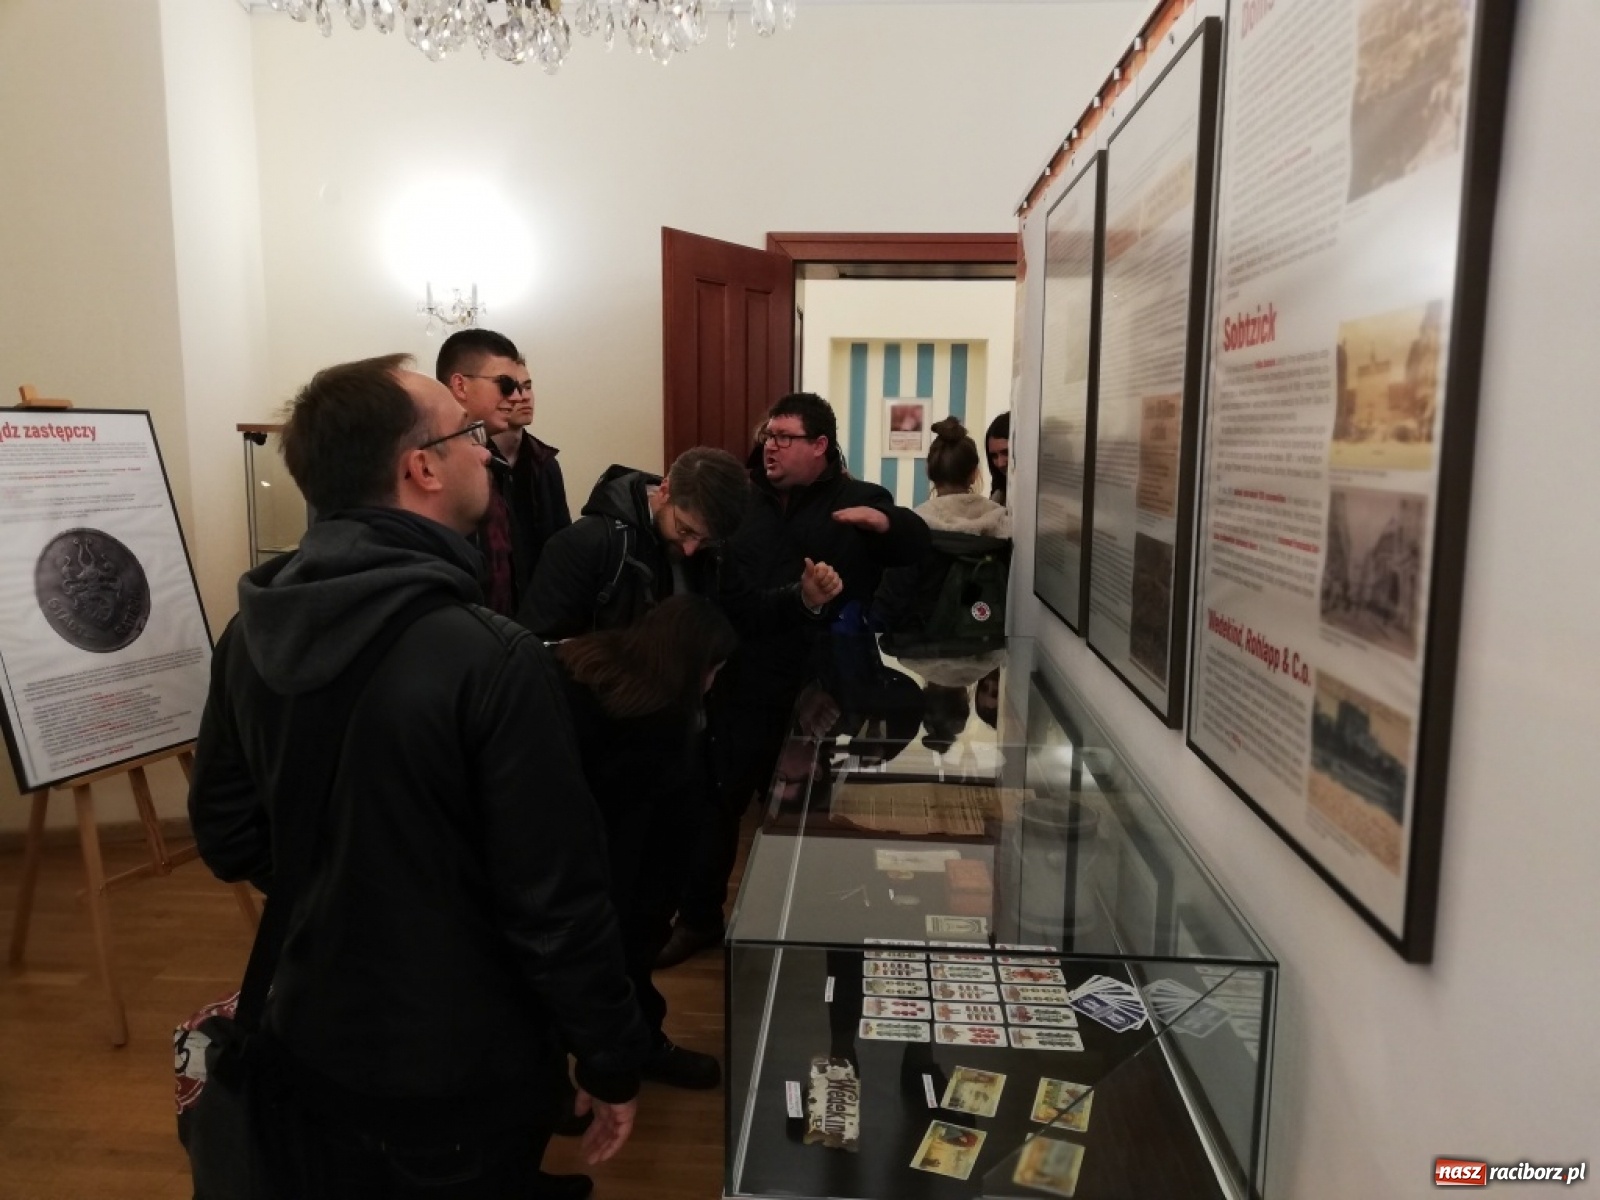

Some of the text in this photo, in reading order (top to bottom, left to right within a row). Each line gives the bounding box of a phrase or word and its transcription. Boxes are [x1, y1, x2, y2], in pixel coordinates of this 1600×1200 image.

[1223, 302, 1277, 352] Sobtzick
[23, 422, 96, 442] zastępczy
[1282, 646, 1289, 674] &
